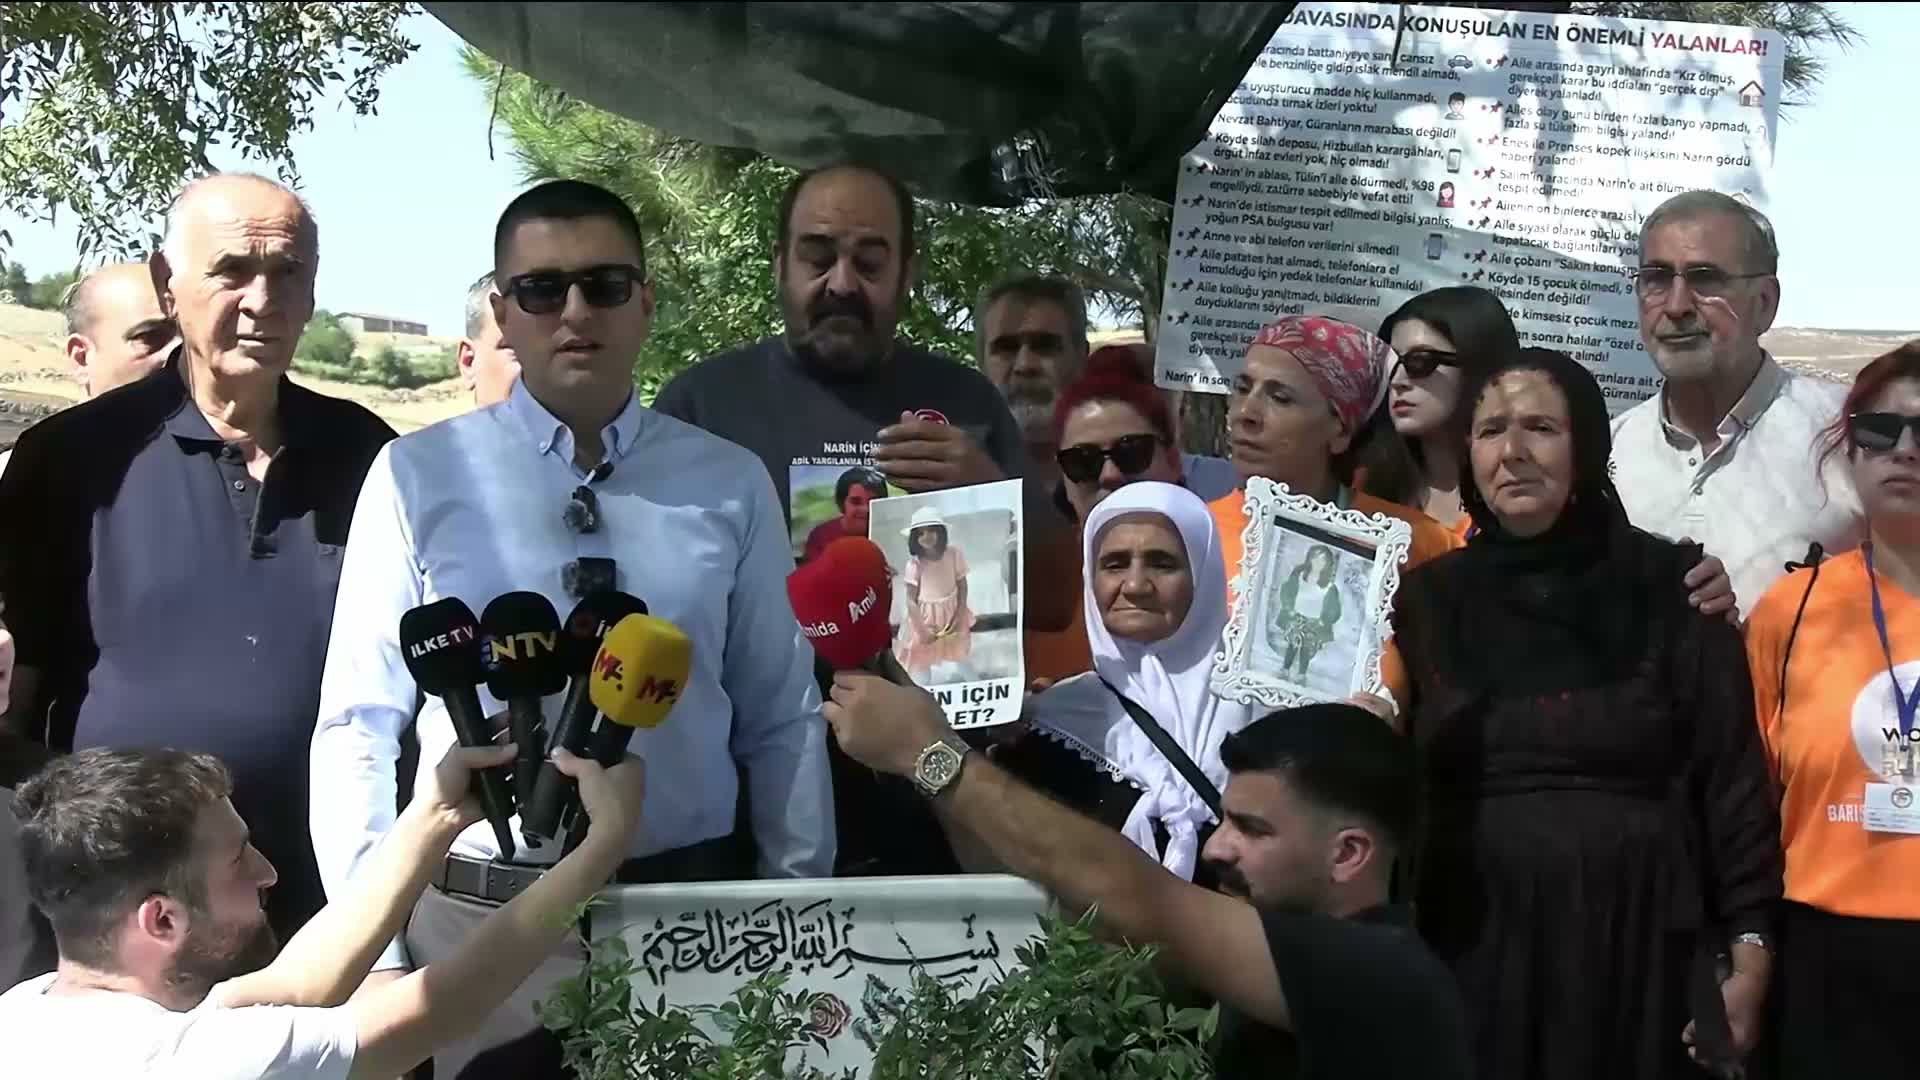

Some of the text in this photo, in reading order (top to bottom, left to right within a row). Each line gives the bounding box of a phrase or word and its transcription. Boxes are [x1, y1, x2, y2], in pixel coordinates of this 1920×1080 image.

[1402, 15, 1526, 41] KONUŞULAN
[1532, 23, 1559, 40] EN
[1566, 24, 1645, 47] ÖNEMLİ
[1651, 32, 1768, 56] YALANLAR!
[1400, 54, 1434, 64] cansız
[1325, 62, 1352, 76] gidip
[1354, 63, 1379, 75] ıslak
[1510, 58, 1532, 69] Aile
[1535, 62, 1582, 73] arasında
[1586, 65, 1614, 77] gayri
[1560, 74, 1588, 87] karar
[1590, 77, 1604, 88] bu
[1250, 83, 1310, 95] uyuşturucu
[1313, 86, 1350, 98] madde
[1353, 88, 1370, 101] hiç
[1507, 84, 1547, 98] diyerek
[1342, 101, 1376, 114] yoktu!
[1217, 112, 1254, 125] Nevzat
[1593, 110, 1628, 123] birden
[1661, 115, 1695, 130] banyo
[1215, 132, 1248, 146] Köyde
[1250, 135, 1275, 146] silah
[1322, 140, 1372, 154] Hizbullah
[1245, 149, 1270, 160] infaz
[1329, 154, 1346, 168] hiç
[1412, 179, 1434, 191] %98
[1307, 187, 1358, 202] sebebiyle
[1360, 191, 1388, 202] vefat
[1254, 201, 1296, 214] istismar
[1299, 205, 1330, 219] tespit
[1332, 207, 1380, 221] edilmedi
[1382, 211, 1416, 225] bilgisi
[1536, 205, 1550, 214] on
[1204, 212, 1333, 231] yoğun PSA bulgusu var!
[1494, 219, 1515, 230] Aile
[1202, 230, 1230, 242] Anne
[1233, 234, 1246, 243] ve
[1248, 234, 1265, 245] abi
[1267, 236, 1304, 248] telefon
[1307, 240, 1354, 252] verilerini
[1200, 249, 1220, 260] Aile
[1223, 252, 1263, 264] patates
[1266, 254, 1283, 265] hat
[1328, 259, 1386, 274] telefonlara
[1489, 253, 1511, 265] Aile
[1513, 256, 1551, 268] çobanı
[1258, 267, 1278, 281] için
[1280, 270, 1312, 282] yedek
[1315, 273, 1366, 286] telefonlar
[1488, 272, 1523, 286] Köyde
[1527, 275, 1540, 286] 15
[1542, 279, 1576, 290] çocuk
[1579, 280, 1622, 295] ölmedi,
[1196, 281, 1217, 293] Aile
[1546, 291, 1590, 306] değildi!
[1191, 315, 1210, 326] Aile
[1215, 319, 1260, 330] arasında
[1522, 309, 1607, 326] kimsesiz çocuk
[1531, 333, 1562, 343] sonra
[1565, 334, 1600, 347] halılar
[1188, 343, 1227, 357] diyerek
[1574, 349, 1609, 362] alındı!
[1637, 376, 1652, 387] ait
[824, 441, 856, 453] NARİN
[792, 456, 862, 465] ADİL YARGILANMA
[490, 631, 556, 662] NTV
[962, 683, 1009, 706] İÇİN
[948, 708, 995, 726] ET?
